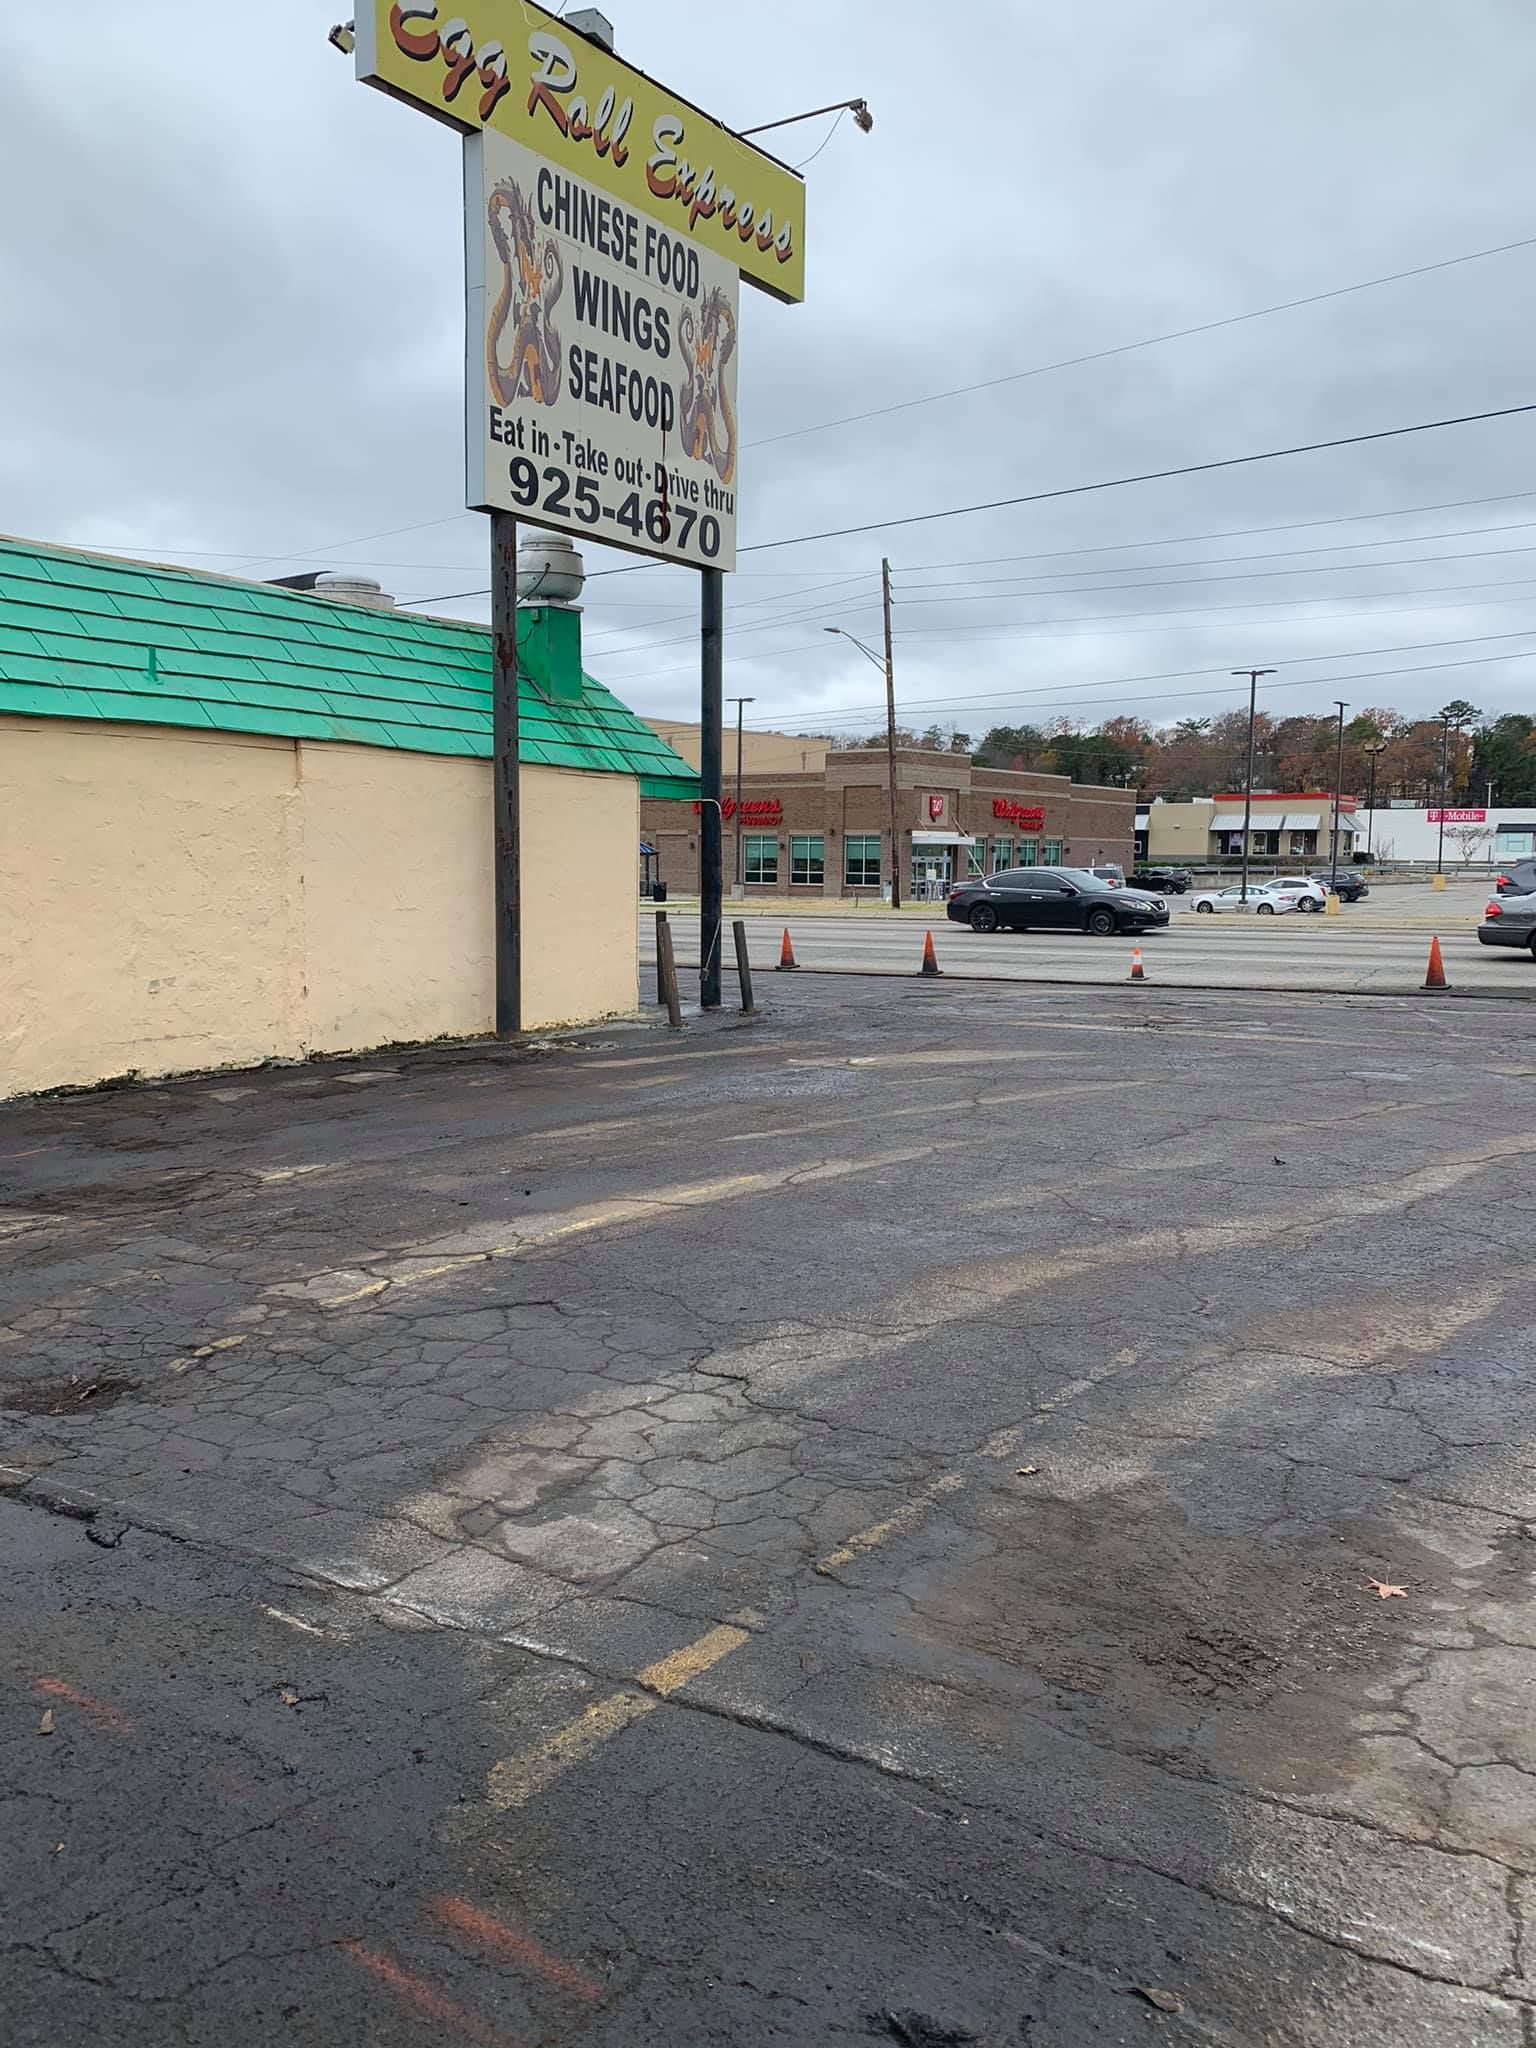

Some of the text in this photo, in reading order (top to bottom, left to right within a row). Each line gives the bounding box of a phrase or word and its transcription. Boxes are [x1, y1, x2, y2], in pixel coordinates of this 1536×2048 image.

[527, 31, 633, 168] Roll
[646, 114, 793, 264] Express
[537, 167, 700, 299] CHINESE FOOD
[572, 265, 671, 359] WINGS
[568, 344, 674, 432] SEAFOOD
[489, 405, 525, 450] Eat
[562, 430, 609, 476] Take
[614, 457, 644, 488] out
[654, 462, 699, 503] Drive
[703, 478, 734, 515] thru
[509, 456, 721, 558] 925-4670
